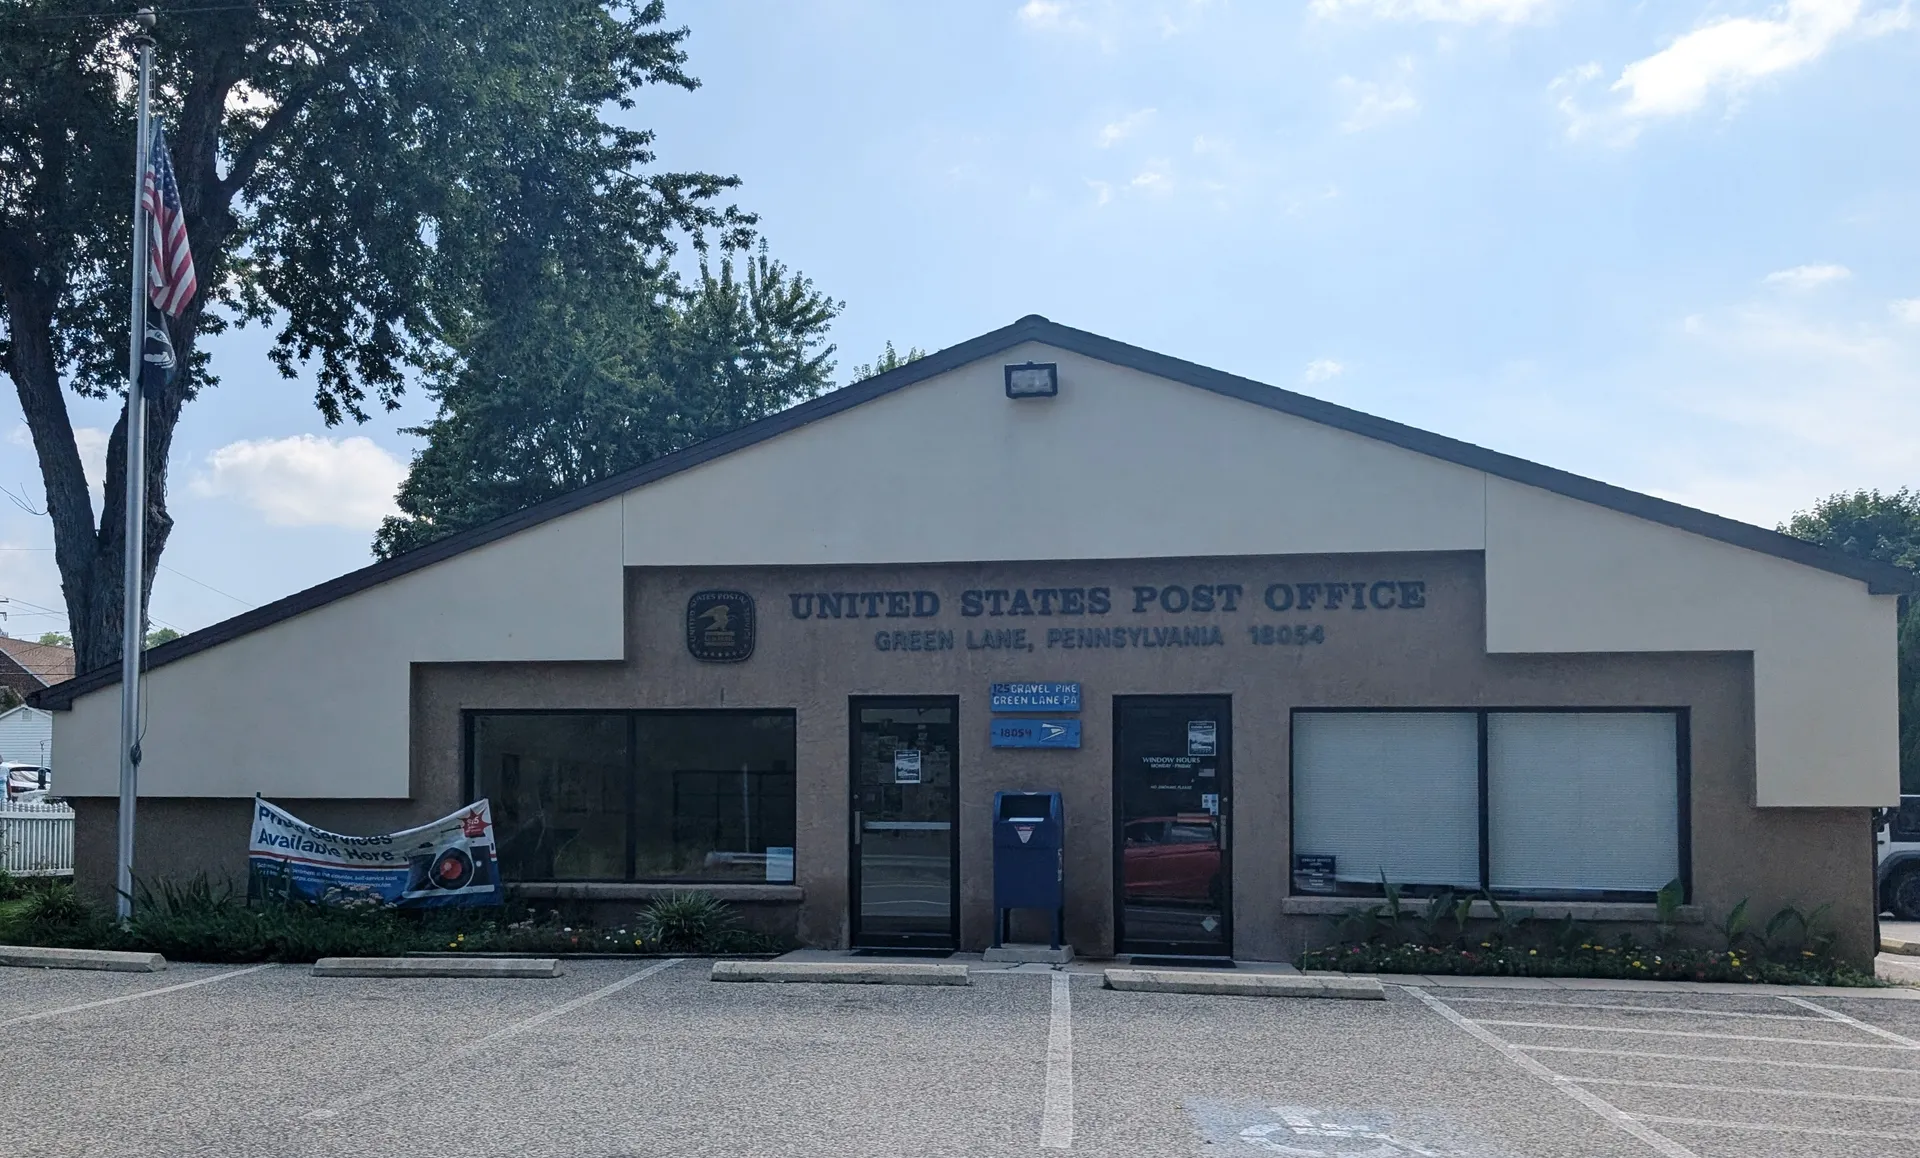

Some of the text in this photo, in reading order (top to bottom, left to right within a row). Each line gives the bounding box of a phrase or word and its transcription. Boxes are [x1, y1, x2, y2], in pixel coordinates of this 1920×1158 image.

[788, 580, 1426, 619] UNITED STATES POST OFFICE
[874, 624, 1326, 652] GREEN LANE, PENNSYLVANIA 18054
[993, 684, 1077, 694] 125 GRAVEL PIKE
[993, 695, 1077, 705] GREEN LANE PA
[1000, 728, 1032, 738] 18054
[257, 828, 341, 858] Available
